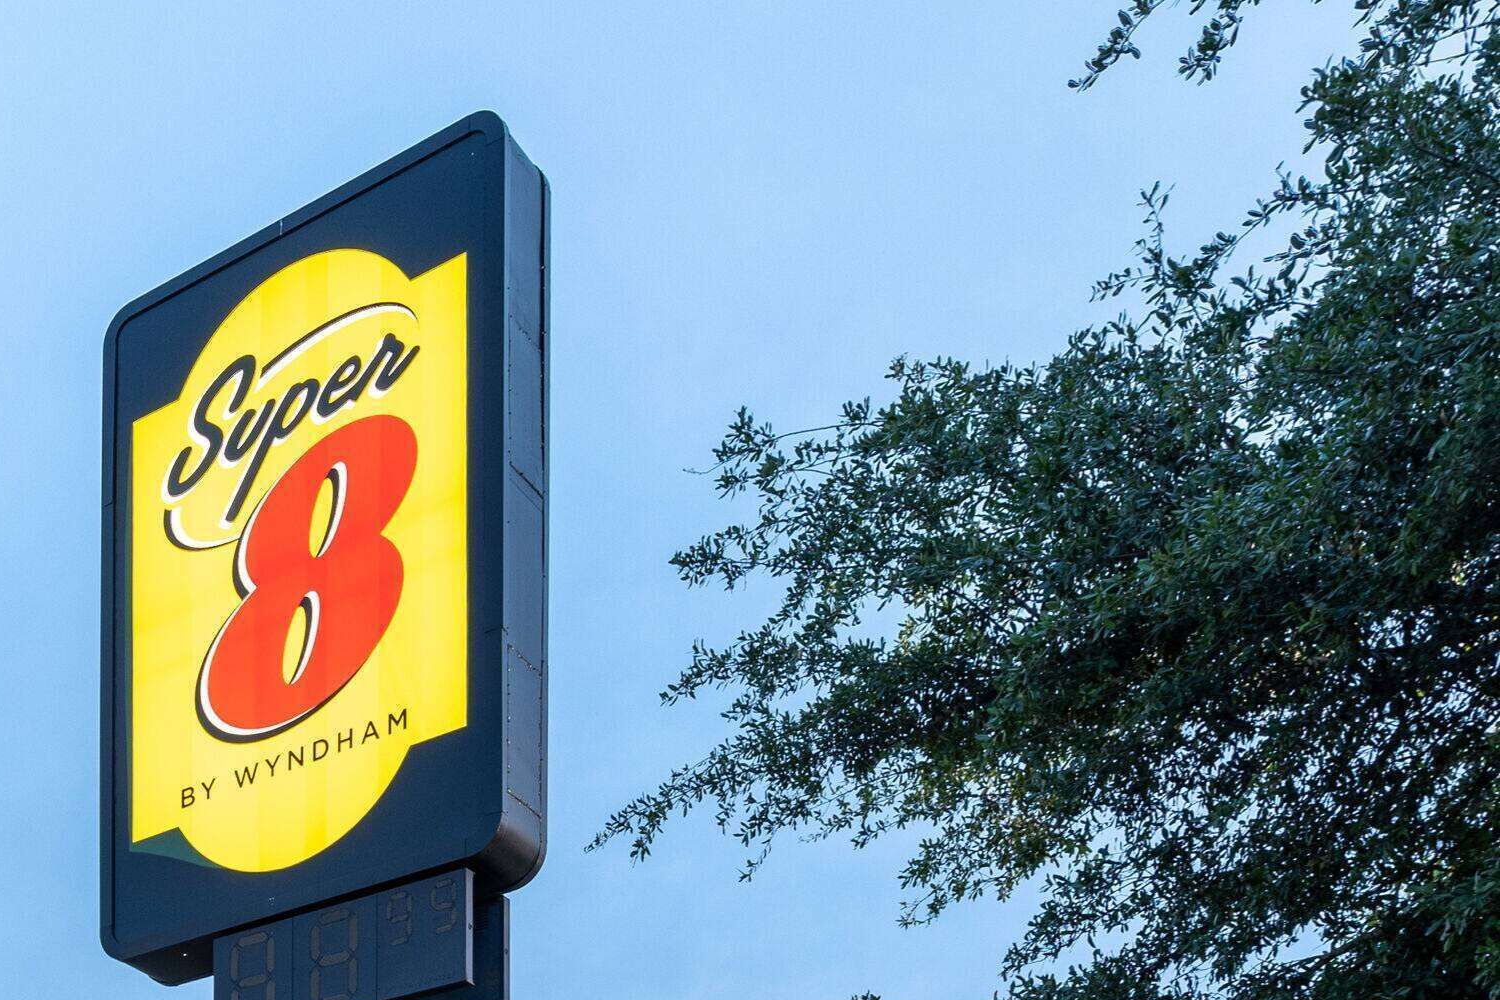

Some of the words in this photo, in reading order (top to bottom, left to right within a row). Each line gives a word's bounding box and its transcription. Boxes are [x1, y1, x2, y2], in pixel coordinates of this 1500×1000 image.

[164, 332, 420, 527] Super
[195, 414, 418, 744] 8
[181, 767, 216, 809] BY
[234, 708, 408, 778] WYNDHAM
